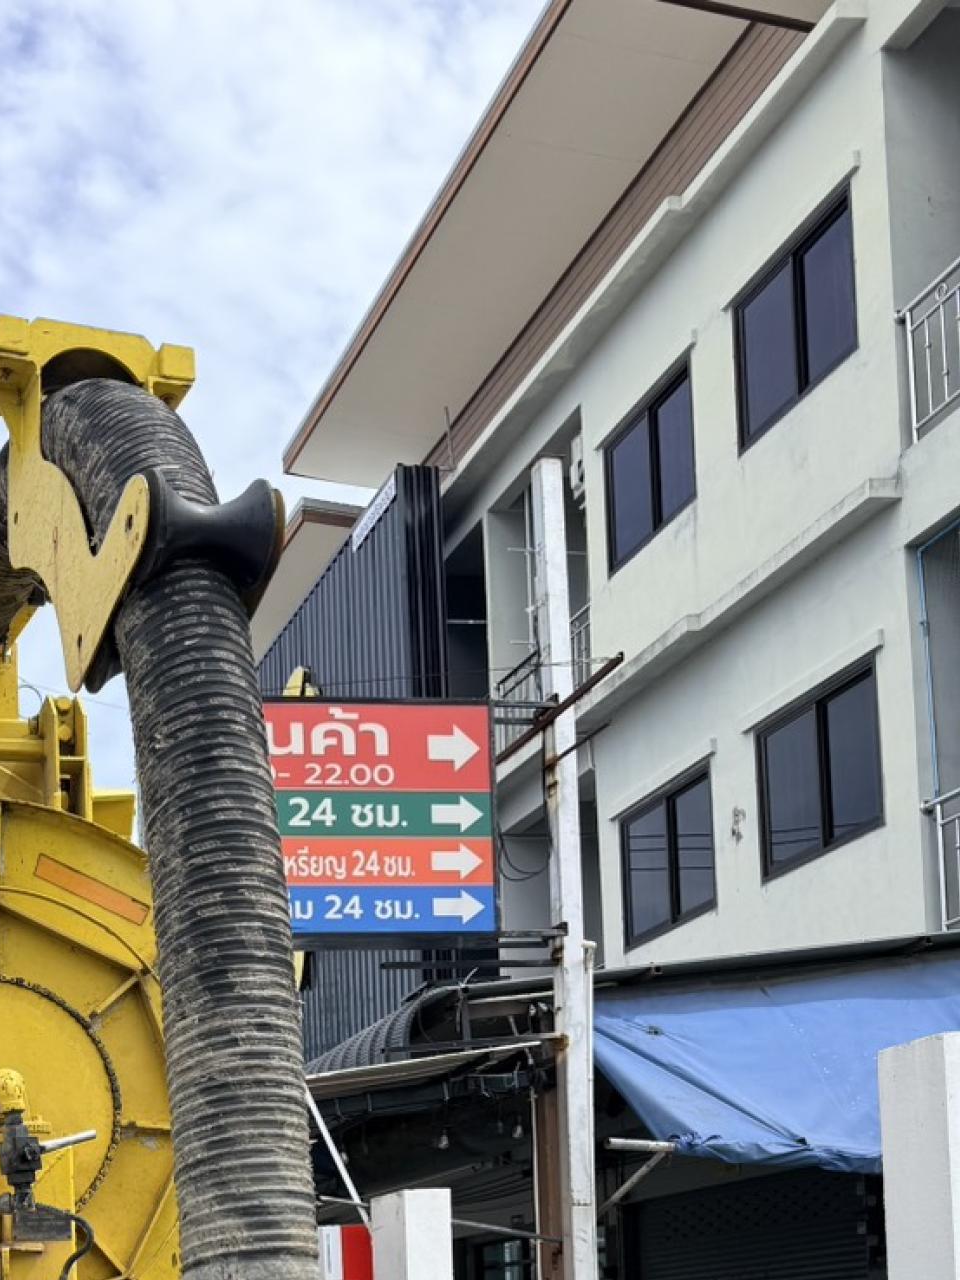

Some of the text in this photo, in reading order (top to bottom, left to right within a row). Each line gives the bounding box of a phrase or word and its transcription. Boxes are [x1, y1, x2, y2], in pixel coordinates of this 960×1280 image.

[266, 706, 389, 755] นค้า
[304, 763, 395, 786] 22.00
[288, 797, 408, 828] 24 ชม.
[284, 846, 416, 880] หรียญ 24 ชม.
[324, 894, 364, 919] 24
[374, 899, 420, 920] ชม.
